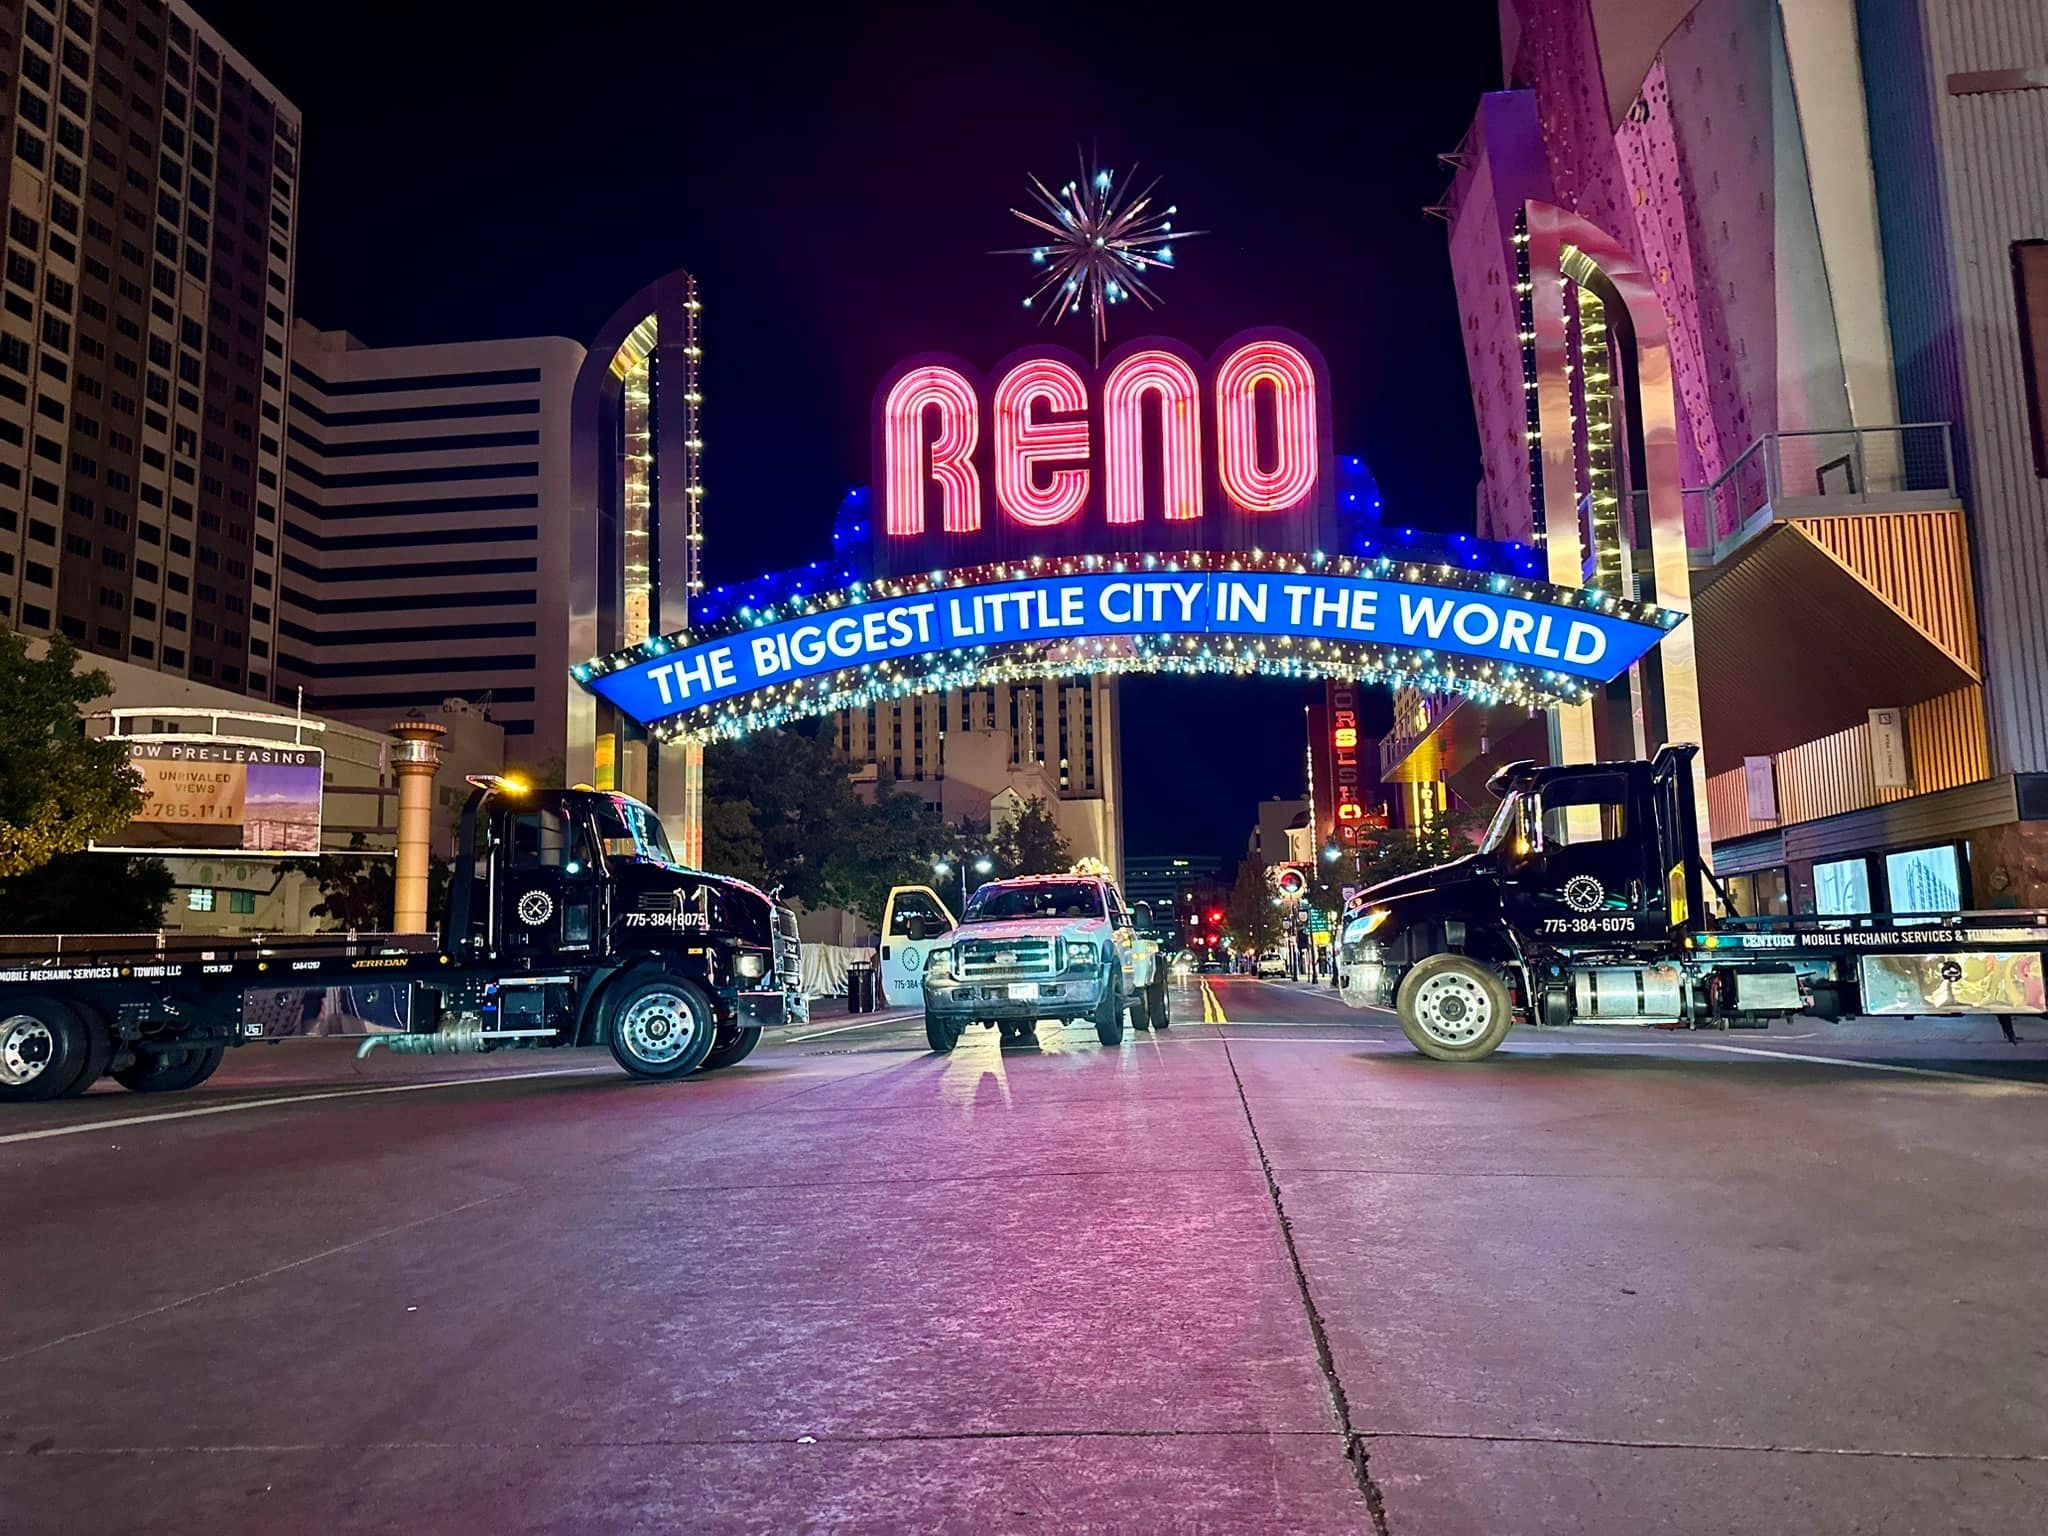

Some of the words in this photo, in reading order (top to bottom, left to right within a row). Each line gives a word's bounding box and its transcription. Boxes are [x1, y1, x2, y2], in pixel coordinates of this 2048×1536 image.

[885, 341, 1318, 535] RENO
[647, 647, 737, 705] THE
[751, 603, 936, 677] BIGGEST
[949, 587, 1085, 637] LITTLE
[1098, 582, 1203, 623] CITY
[1216, 583, 1267, 622] IN
[1283, 585, 1378, 631] THE
[1400, 594, 1608, 665] WORLD
[127, 744, 161, 757] OW
[172, 748, 306, 764] PRE-LEASING
[159, 771, 231, 783] UNRIVALED
[176, 784, 215, 794] VIEWS
[1544, 917, 1635, 933] 775-384-6075
[1801, 934, 1841, 946] MOBILE
[1843, 932, 1900, 946] MECHANIC
[1901, 930, 1953, 943] SERVICES
[1954, 929, 1963, 942] &
[30, 969, 72, 981] MECHANIC
[73, 967, 111, 979] SERVICES
[113, 967, 119, 978] &
[133, 966, 165, 977] TOWING
[167, 965, 182, 976] LLC
[894, 979, 923, 989] 775-384-
